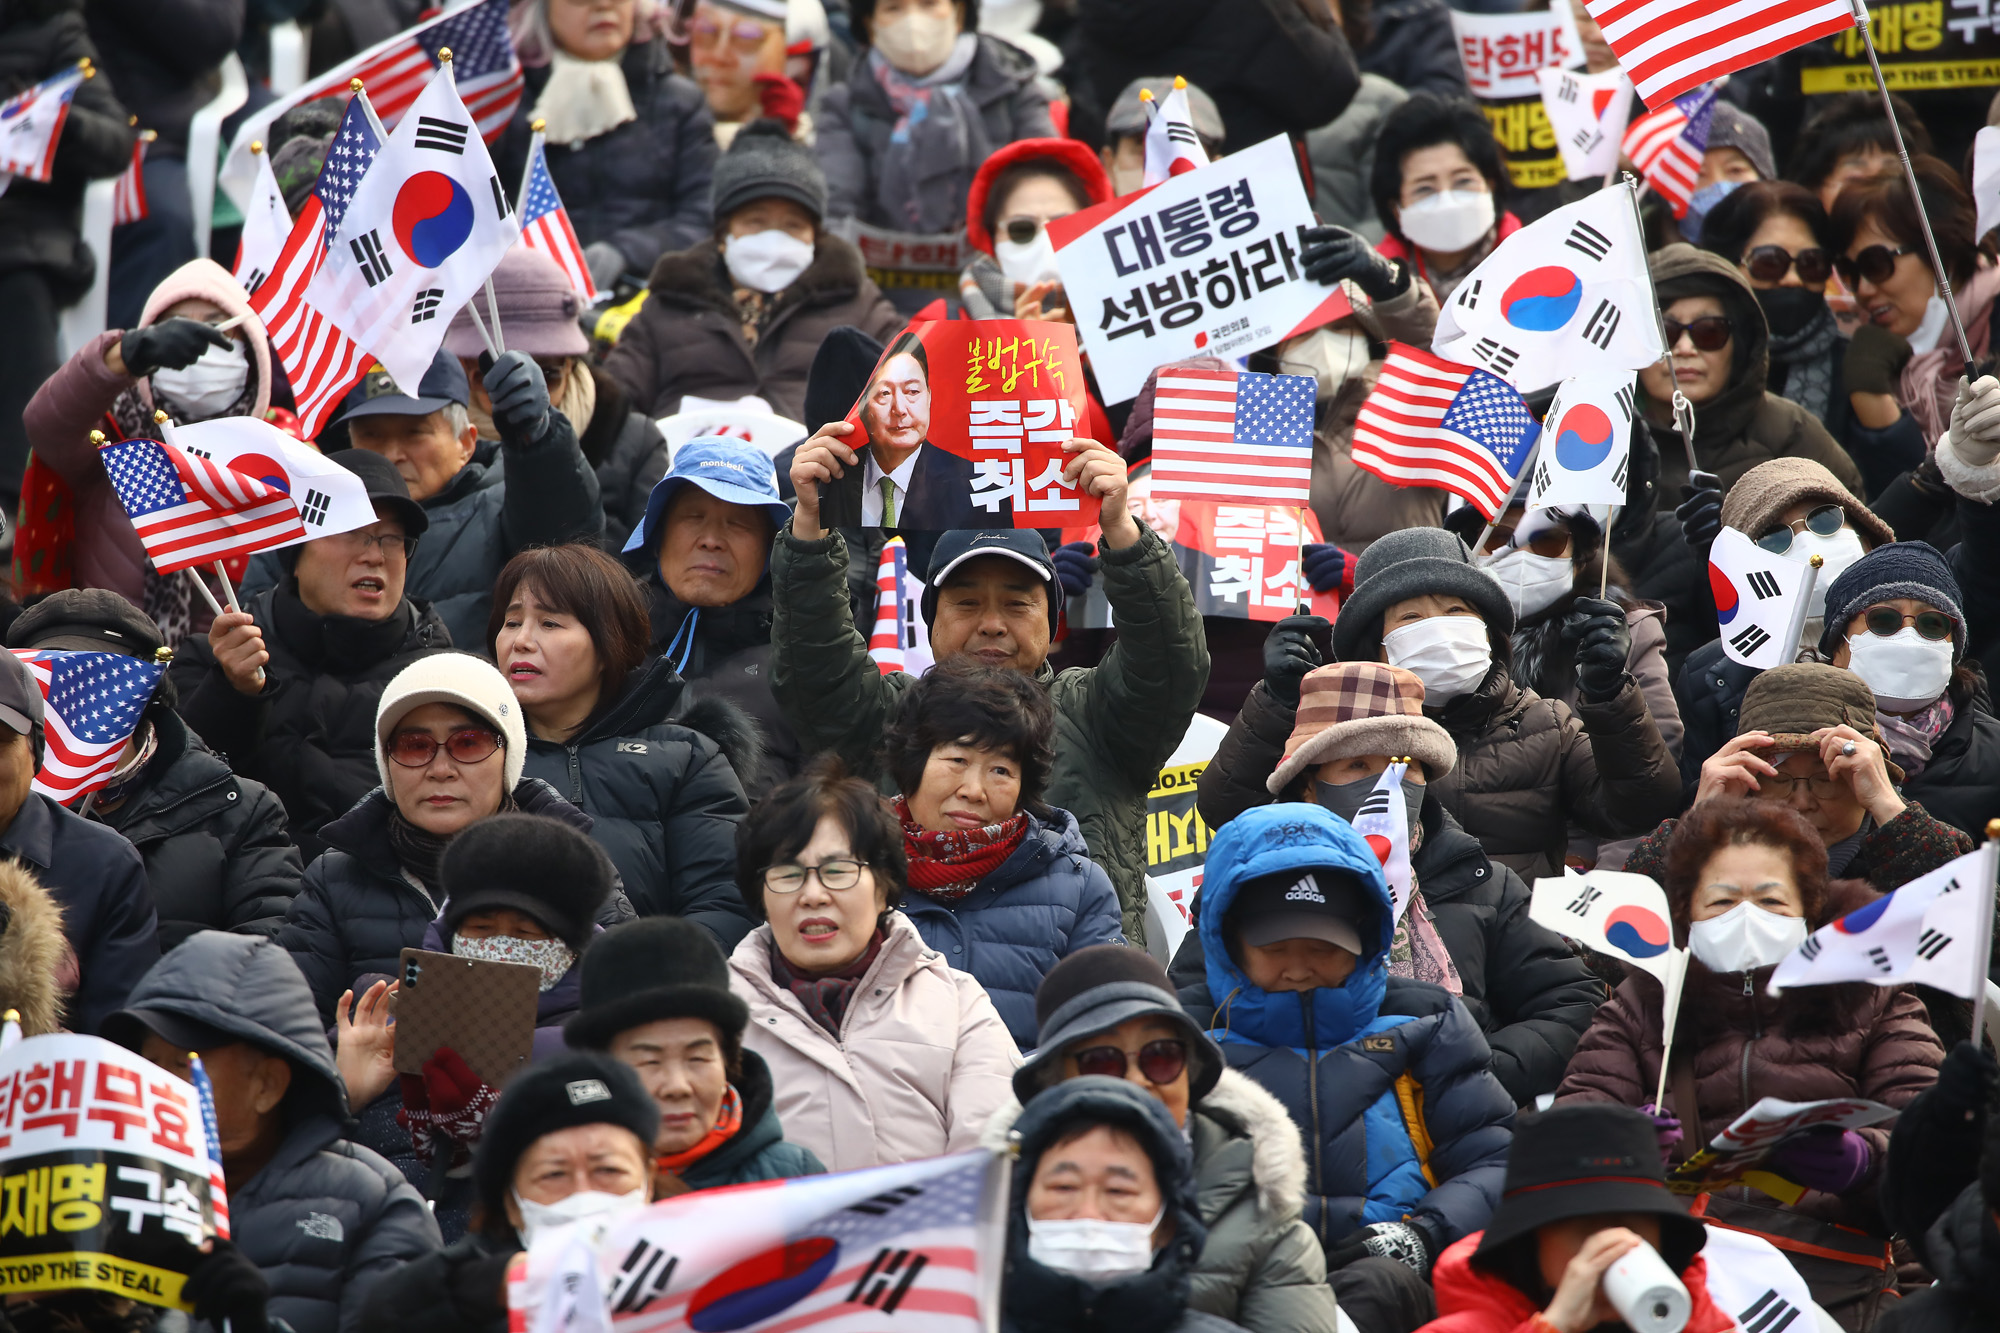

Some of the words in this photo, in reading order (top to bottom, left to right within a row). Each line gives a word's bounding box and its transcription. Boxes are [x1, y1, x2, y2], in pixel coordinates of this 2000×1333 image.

[1902, 69, 1937, 83] THE
[1480, 102, 1558, 152] 재명
[1103, 178, 1260, 278] 대통령
[966, 336, 1066, 394] 불법구속
[968, 399, 1076, 454] 즉각
[969, 458, 1080, 513] 취소
[1209, 555, 1312, 609] 취소
[616, 742, 648, 755] K2
[1285, 890, 1326, 904] adidas
[1365, 1038, 1393, 1050] K2
[0, 1162, 107, 1239] 재명
[110, 1165, 204, 1247] 구속
[48, 1261, 91, 1281] THE
[96, 1262, 163, 1297] STEAL
